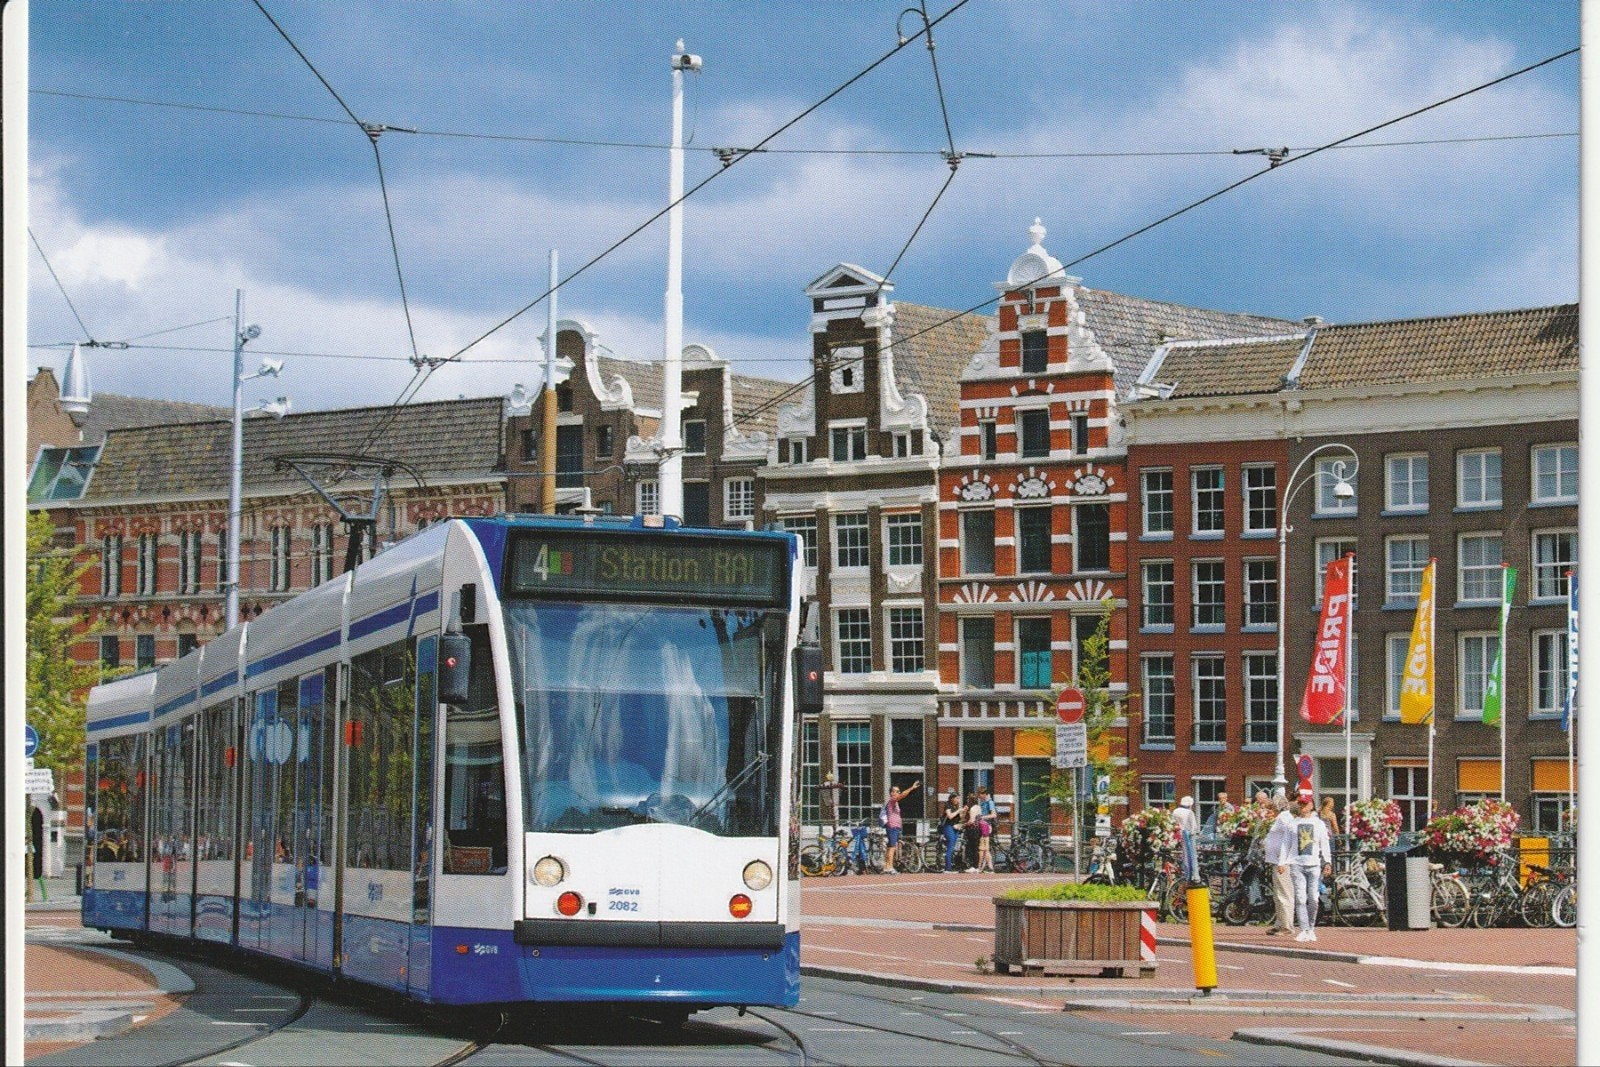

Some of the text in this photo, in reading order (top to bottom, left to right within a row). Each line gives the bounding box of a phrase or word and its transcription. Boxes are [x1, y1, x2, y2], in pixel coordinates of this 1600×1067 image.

[533, 543, 754, 585] 4 Station RAI
[608, 900, 638, 912] 2082
